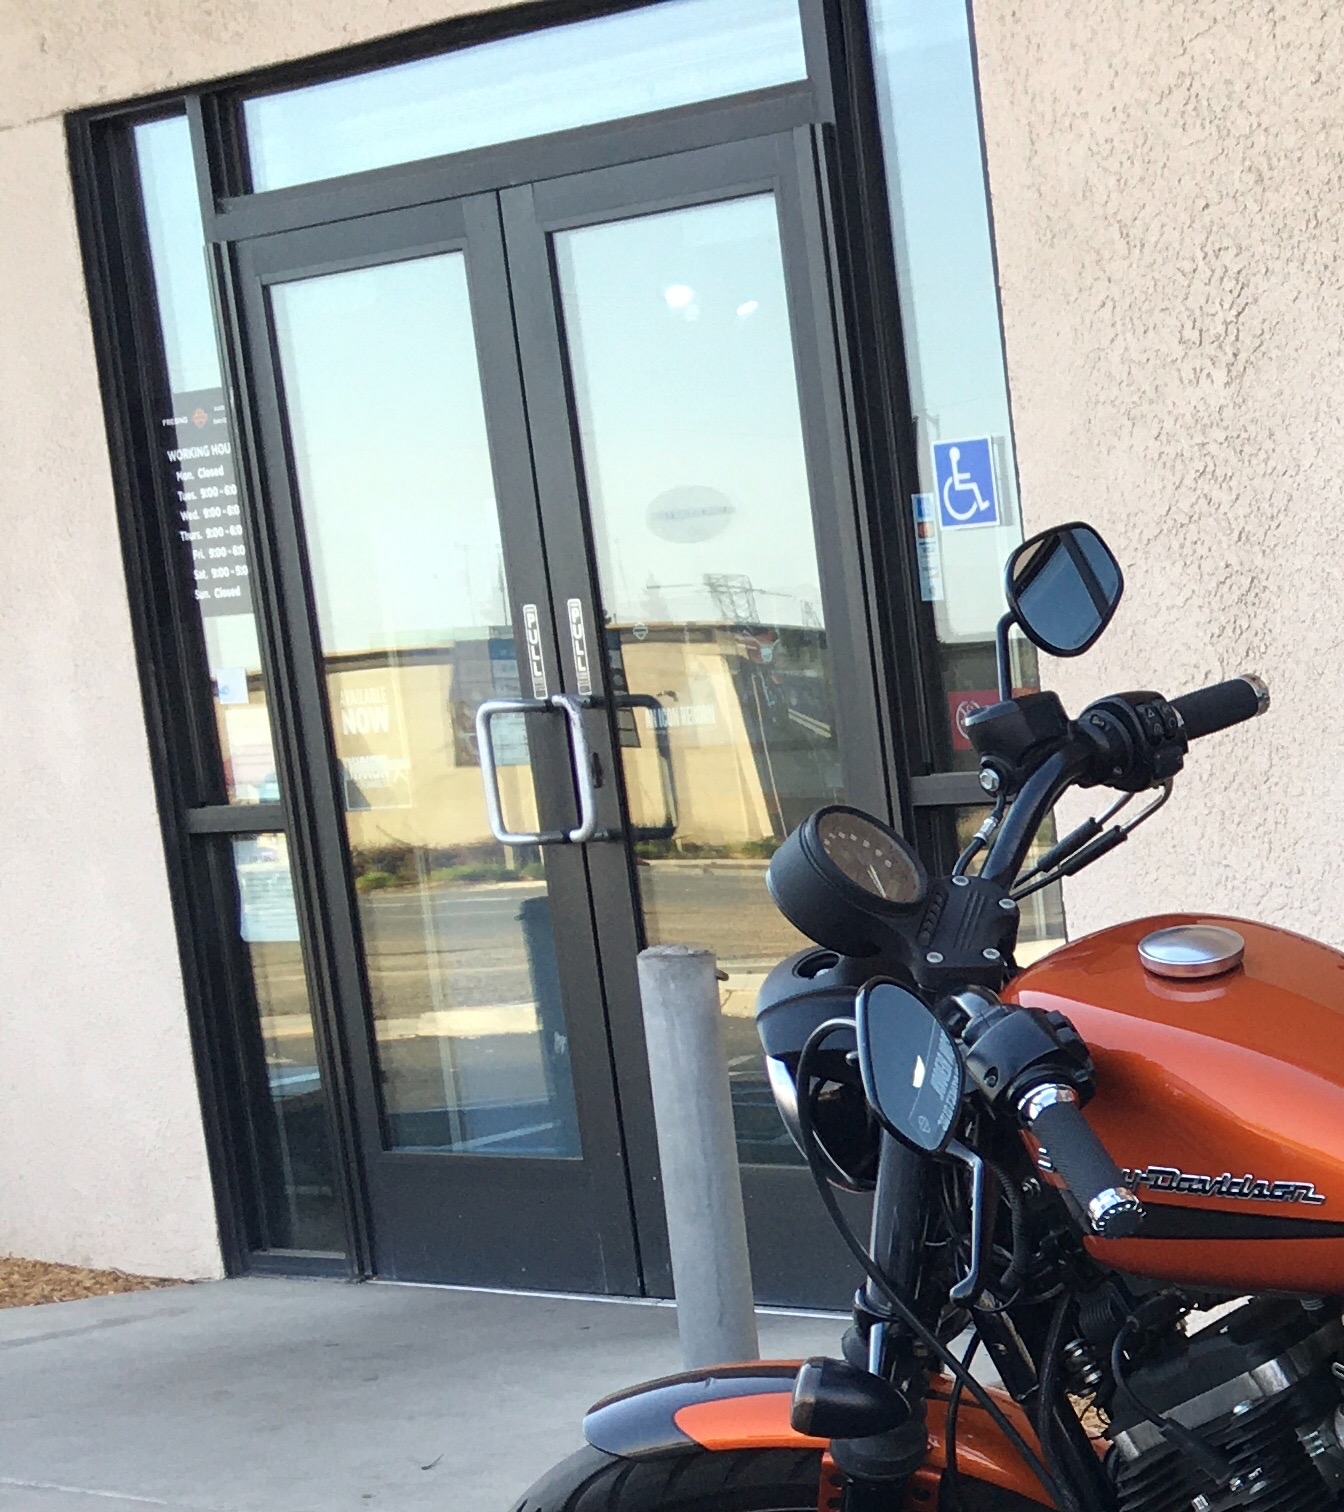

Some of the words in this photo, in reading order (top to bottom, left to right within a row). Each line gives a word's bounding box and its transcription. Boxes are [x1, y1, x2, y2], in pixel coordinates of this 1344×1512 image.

[167, 444, 210, 462] WORKING
[198, 465, 224, 479] Closed
[214, 586, 241, 598] Closed
[527, 612, 542, 676] PULL
[571, 607, 586, 671] PULL
[341, 704, 389, 735] NOW
